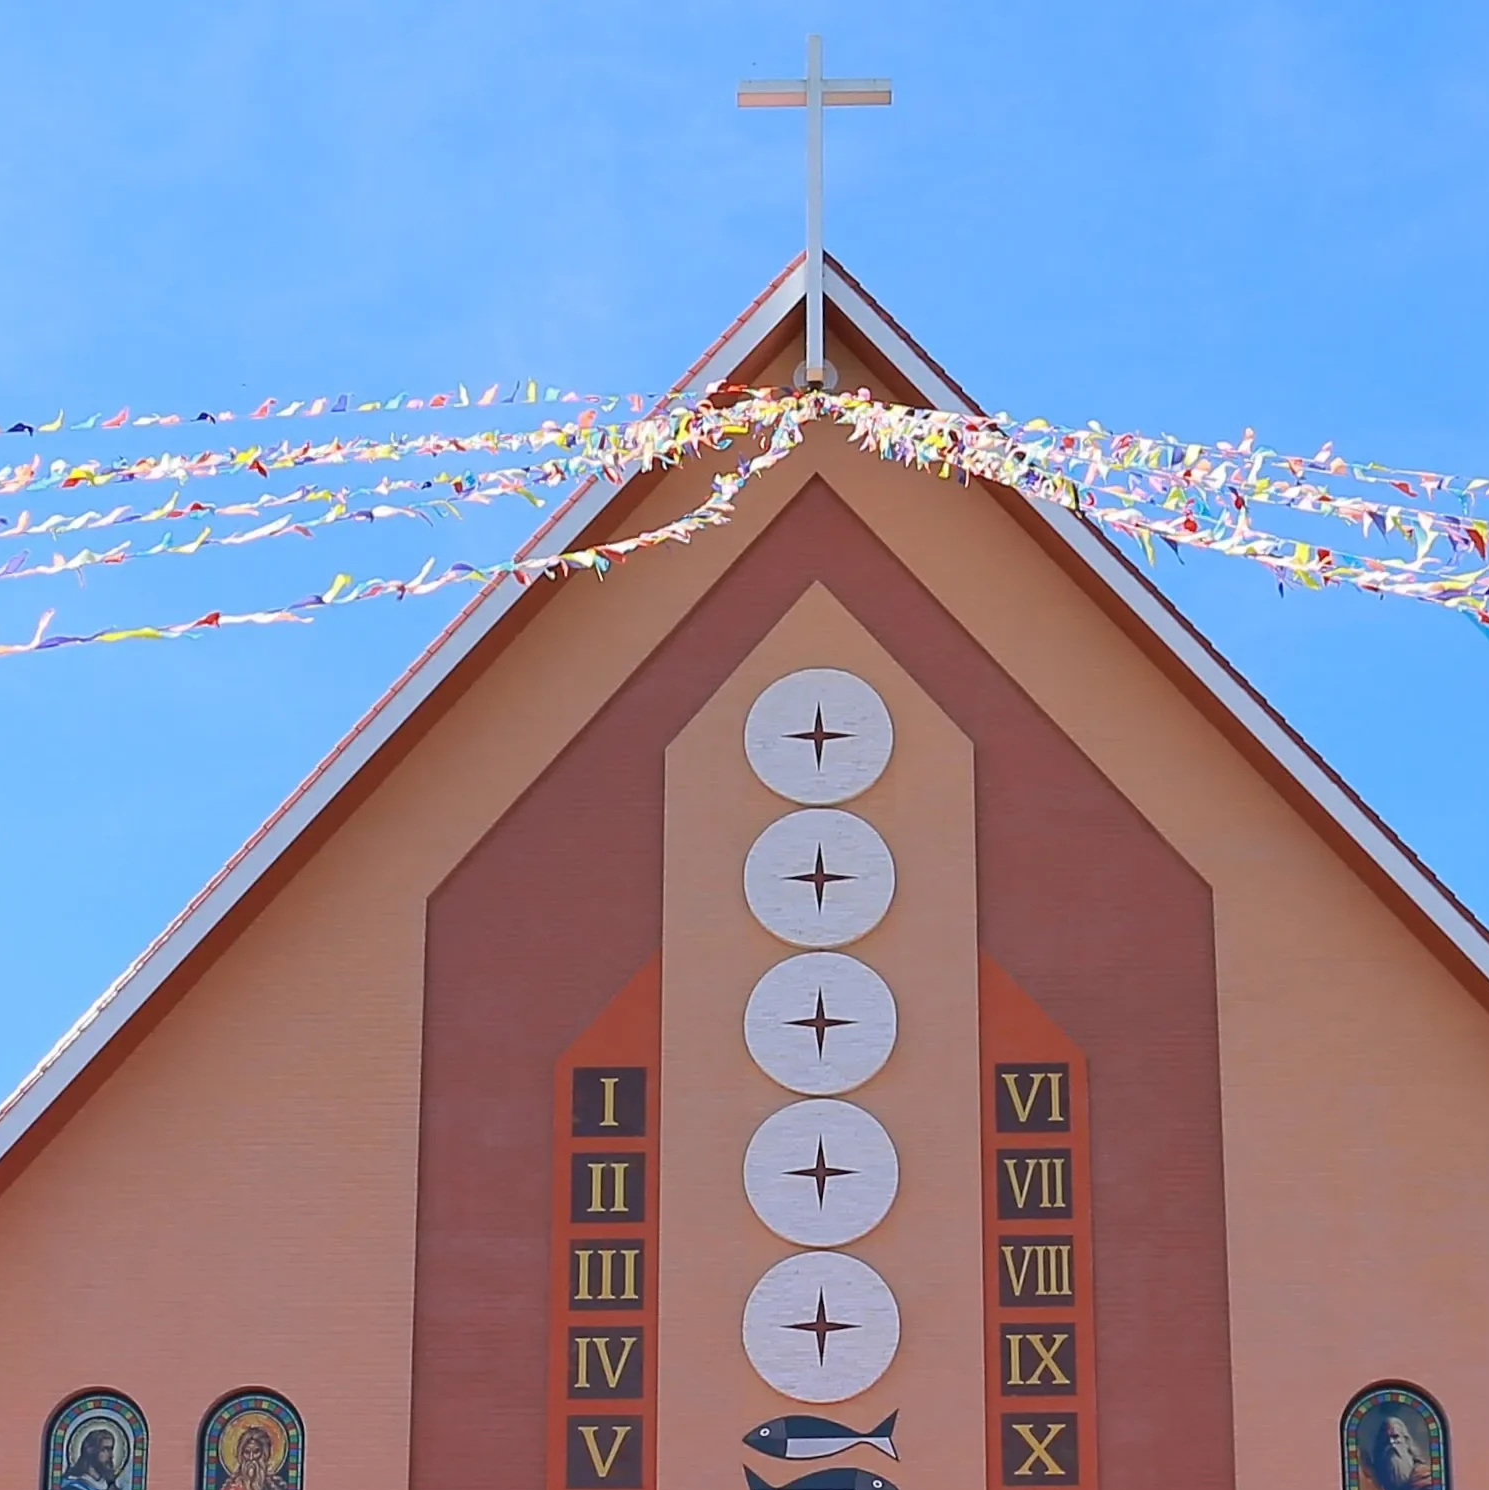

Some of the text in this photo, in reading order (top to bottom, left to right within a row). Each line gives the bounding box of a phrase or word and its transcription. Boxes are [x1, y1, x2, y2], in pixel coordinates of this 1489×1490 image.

[599, 1077, 619, 1126] I
[1002, 1073, 1064, 1122] VI
[586, 1163, 630, 1213] II
[1004, 1159, 1066, 1209] VII
[574, 1250, 640, 1300] III
[1000, 1246, 1073, 1297] VIII
[574, 1337, 637, 1388] IV
[1006, 1334, 1070, 1385] IX
[578, 1426, 631, 1478] V
[1013, 1424, 1066, 1475] X
